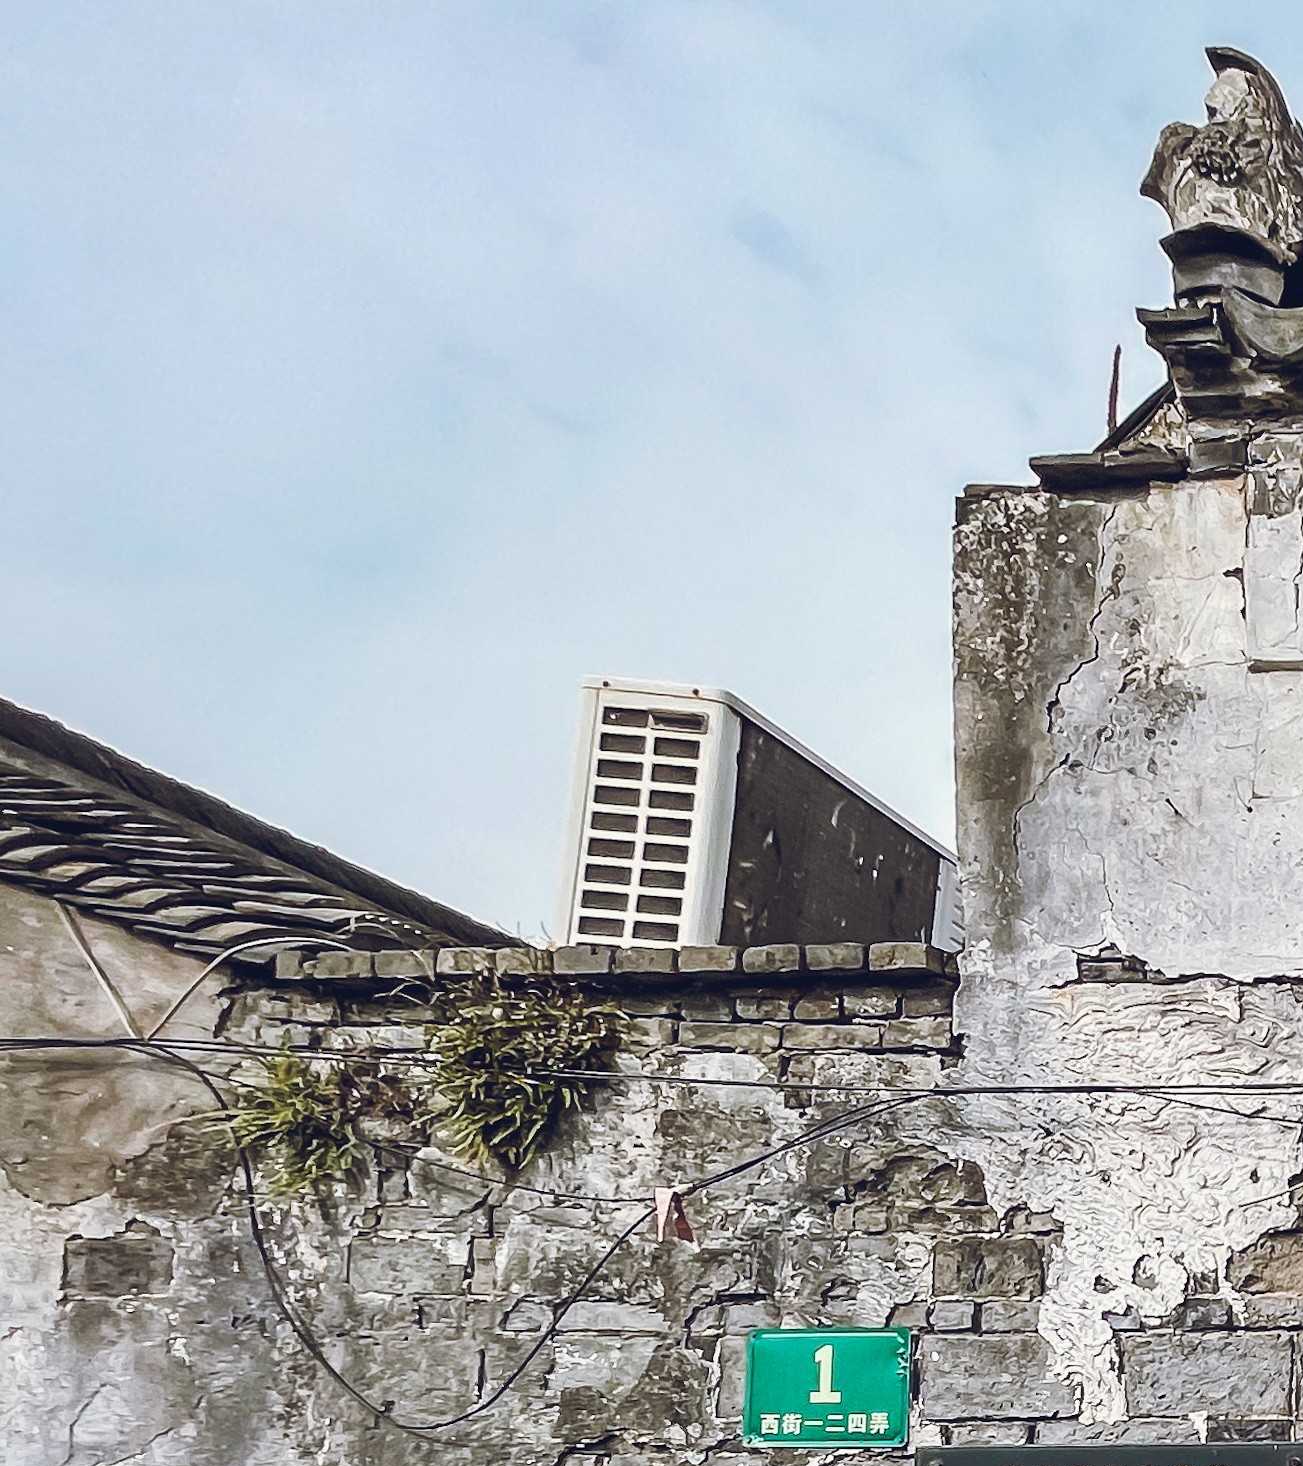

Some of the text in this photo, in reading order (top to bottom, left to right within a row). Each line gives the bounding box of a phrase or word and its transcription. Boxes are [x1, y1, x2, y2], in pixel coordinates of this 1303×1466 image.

[809, 1344, 842, 1404] 1
[760, 1412, 889, 1435] 西街一二四弄
